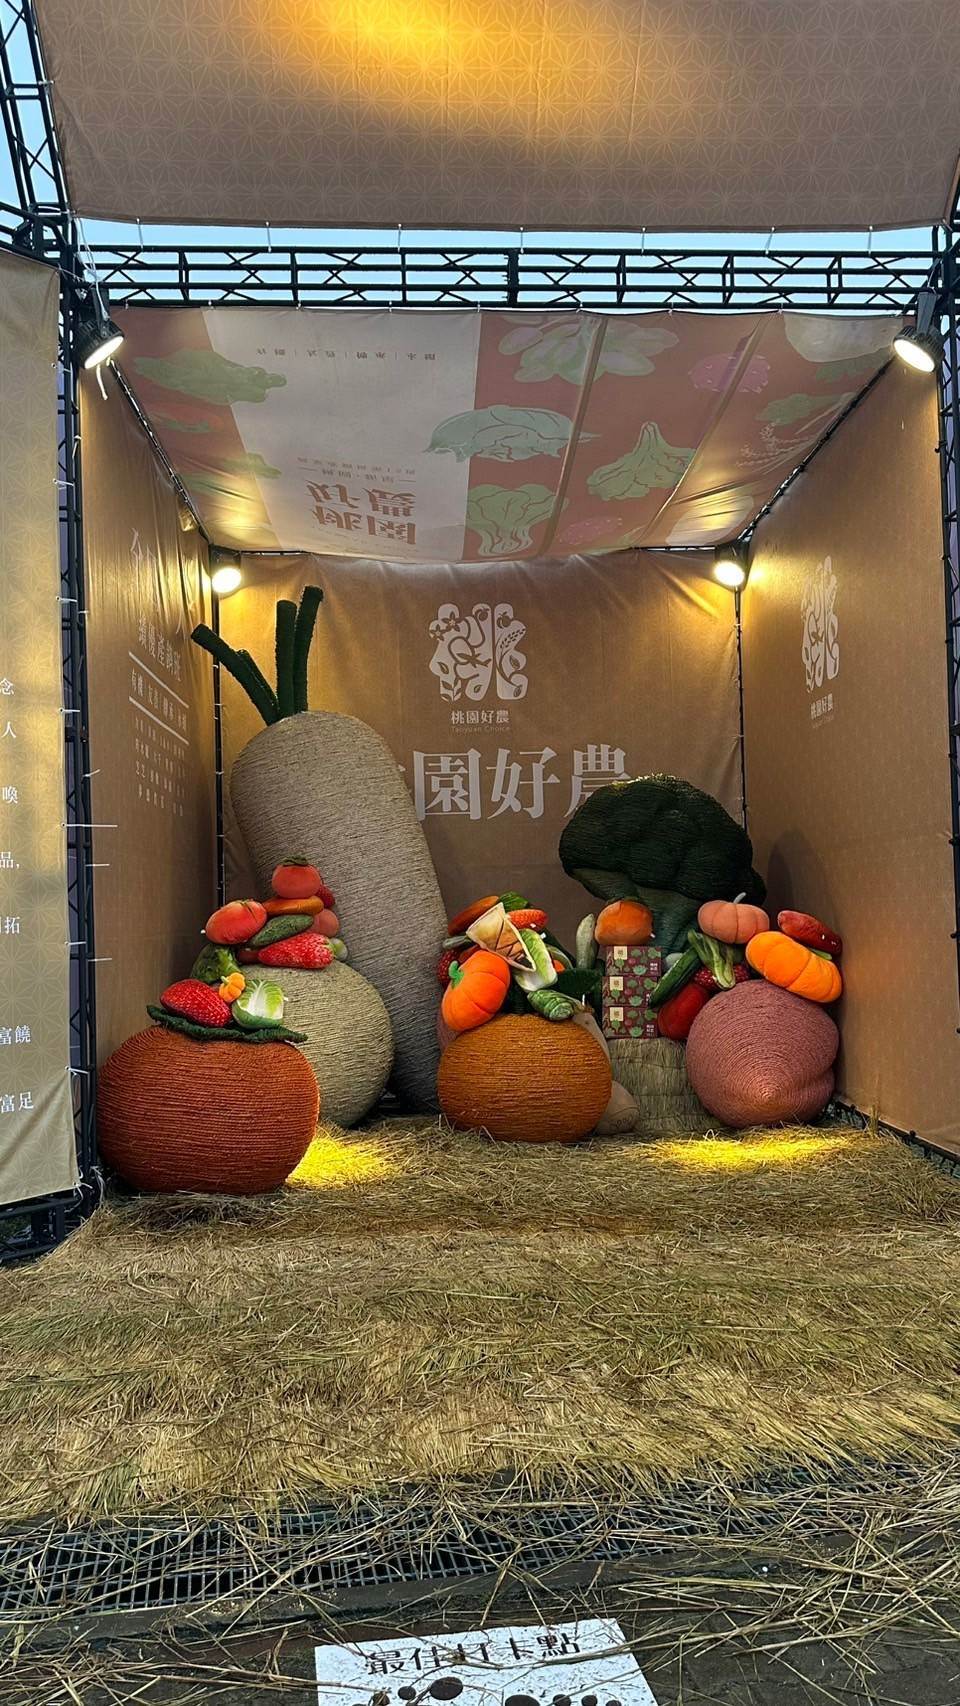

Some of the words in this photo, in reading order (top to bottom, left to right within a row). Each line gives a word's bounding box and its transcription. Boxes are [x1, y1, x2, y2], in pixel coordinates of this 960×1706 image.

[451, 710, 509, 724] 桃園好農
[1, 721, 16, 738] 人
[396, 744, 630, 821] 園好農
[0, 1091, 34, 1113] 富足
